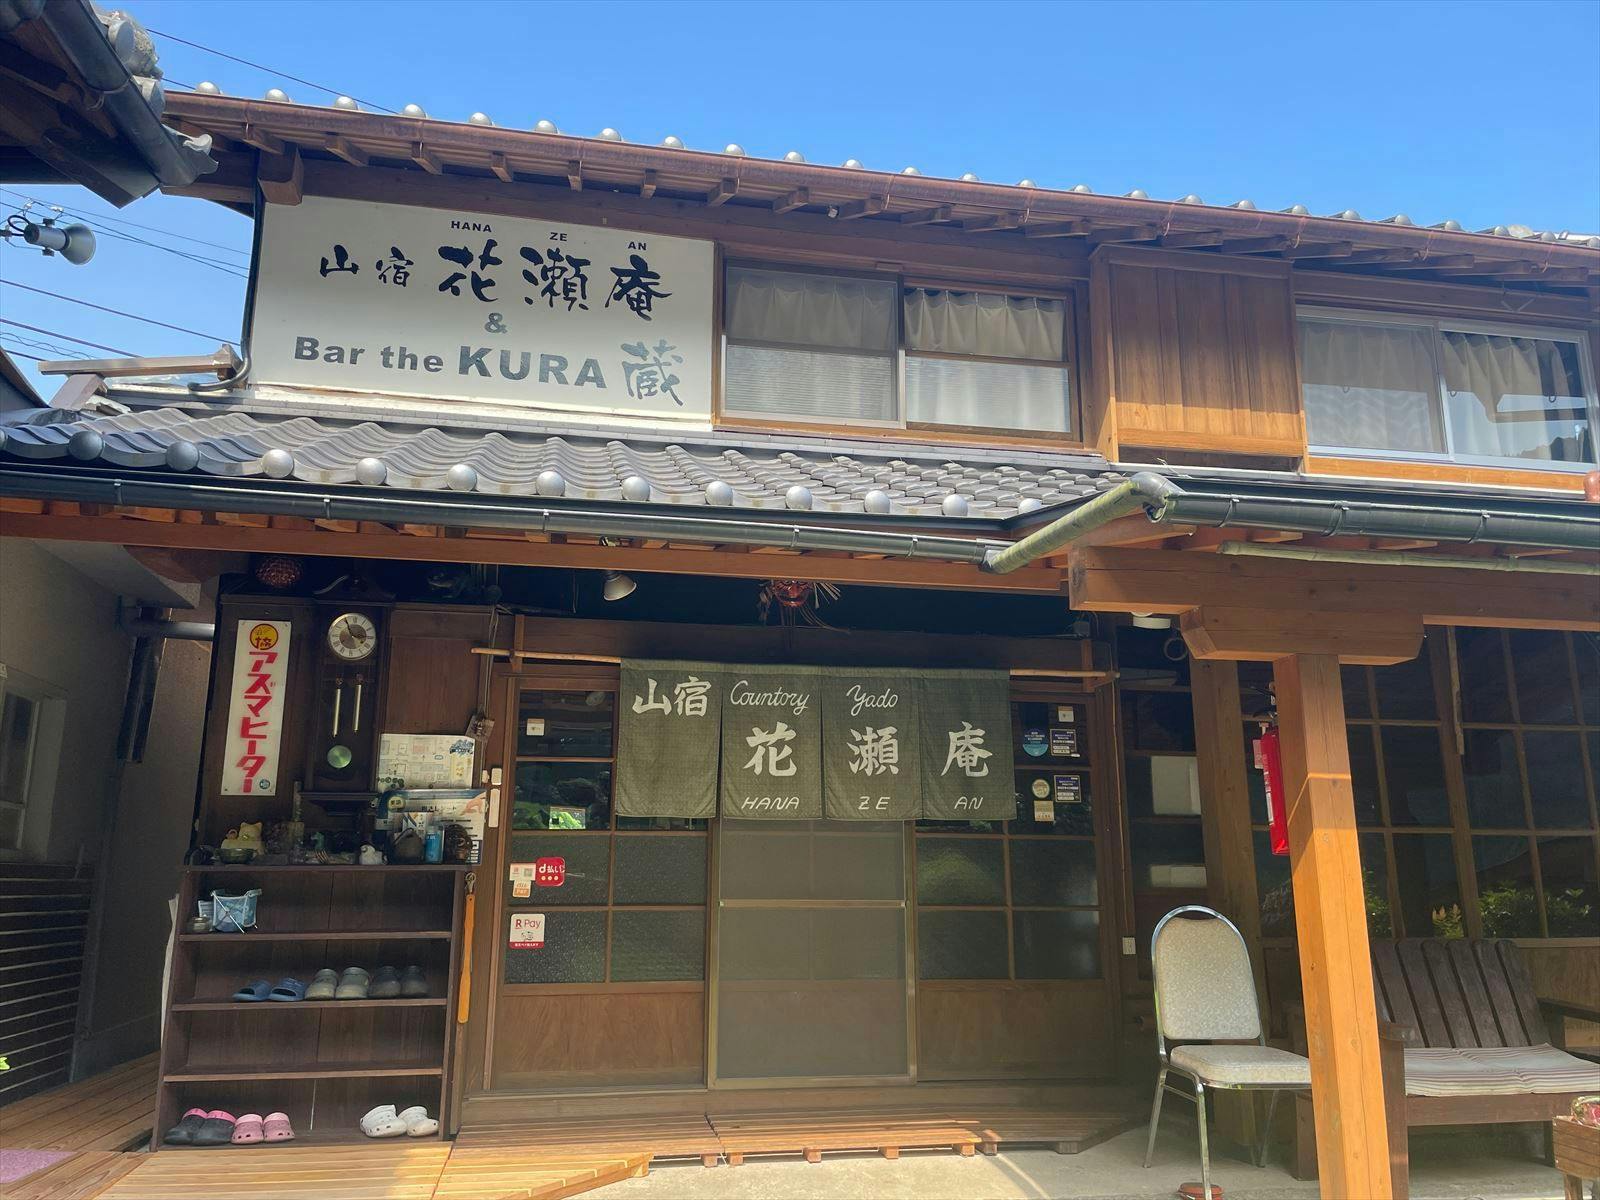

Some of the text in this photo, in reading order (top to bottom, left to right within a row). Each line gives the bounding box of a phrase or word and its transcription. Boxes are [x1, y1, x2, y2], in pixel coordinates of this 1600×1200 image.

[451, 220, 648, 251] HANA ZE AN
[319, 244, 415, 287] 山宿
[484, 312, 508, 334] &
[294, 336, 684, 407] Bar the KURA 蔵
[631, 676, 899, 718] 山宿 Countory Yado
[236, 651, 278, 793] アズマヒーター
[741, 796, 801, 811] HANA
[953, 797, 984, 811] AN
[515, 918, 541, 929] R Pay
